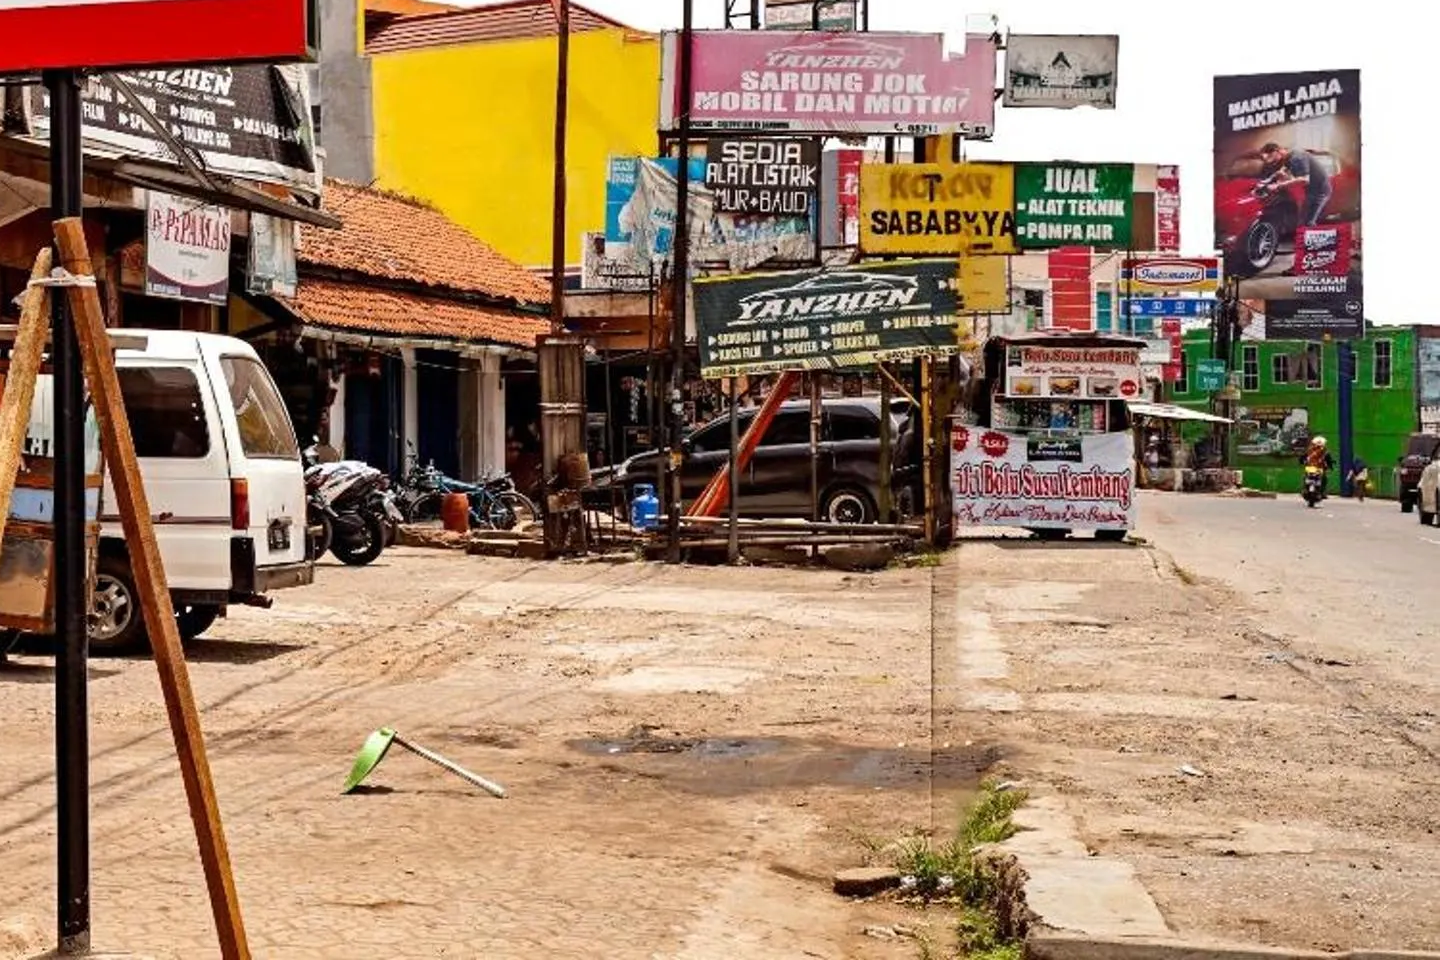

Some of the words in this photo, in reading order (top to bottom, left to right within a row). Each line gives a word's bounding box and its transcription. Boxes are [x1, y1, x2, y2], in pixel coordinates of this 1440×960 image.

[740, 71, 863, 92] SARUNG
[871, 74, 926, 93] JOK
[693, 92, 788, 113] MOBIL
[794, 94, 856, 114] DAN
[1228, 92, 1280, 117] MAKIN
[1284, 78, 1343, 107] LAMA
[1232, 110, 1286, 132] MAKIN
[1290, 98, 1338, 121] JADI
[721, 141, 802, 164] SEDIA
[706, 163, 751, 186] ALAT
[752, 164, 817, 187] LISTRIK
[1044, 168, 1100, 193] JUAL
[760, 191, 808, 213] BAUD
[1028, 199, 1066, 216] ALAT
[1069, 199, 1126, 217] TEKNIK
[1027, 222, 1084, 240] POMPA
[1085, 224, 1114, 240] AIR
[738, 288, 918, 321] YANZHEN
[981, 463, 1019, 496] Bolu
[1022, 468, 1060, 498] Susu
[1061, 465, 1133, 508] Lembang
